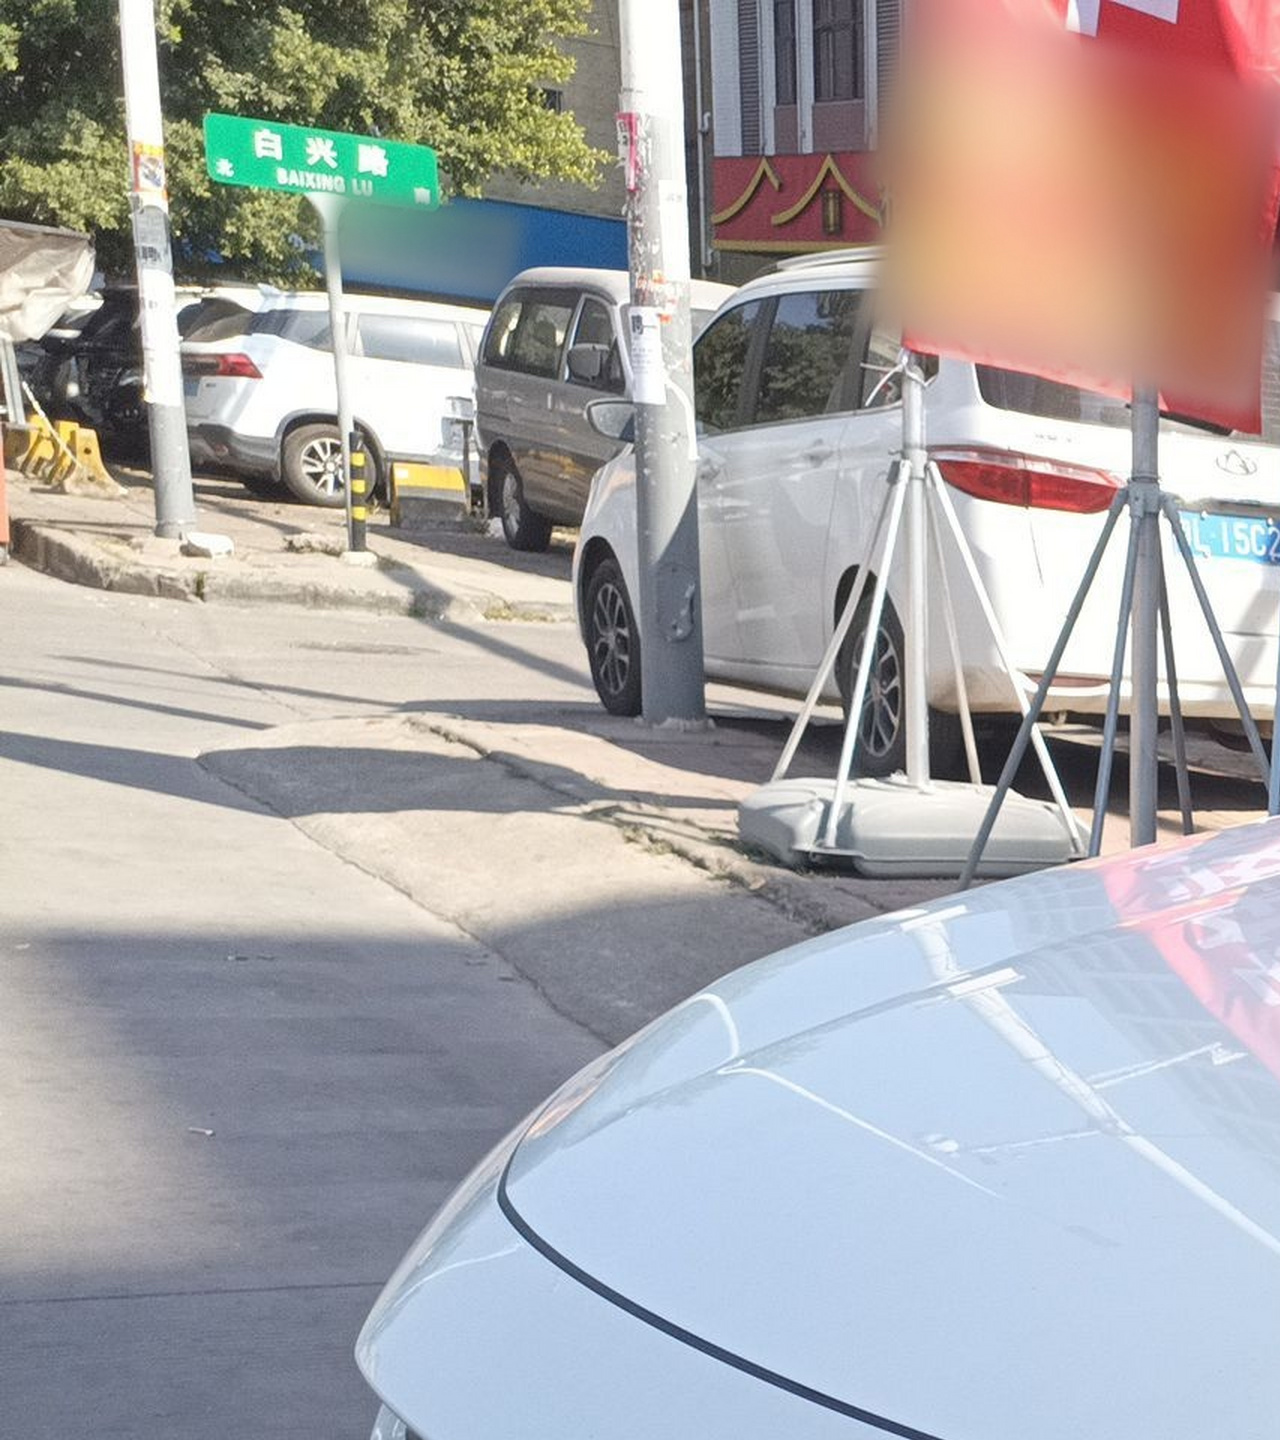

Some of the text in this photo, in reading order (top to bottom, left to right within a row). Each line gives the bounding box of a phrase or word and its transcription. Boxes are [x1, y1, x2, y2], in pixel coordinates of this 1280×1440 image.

[254, 128, 389, 178] 白兴路
[276, 167, 373, 197] BAIXING LU
